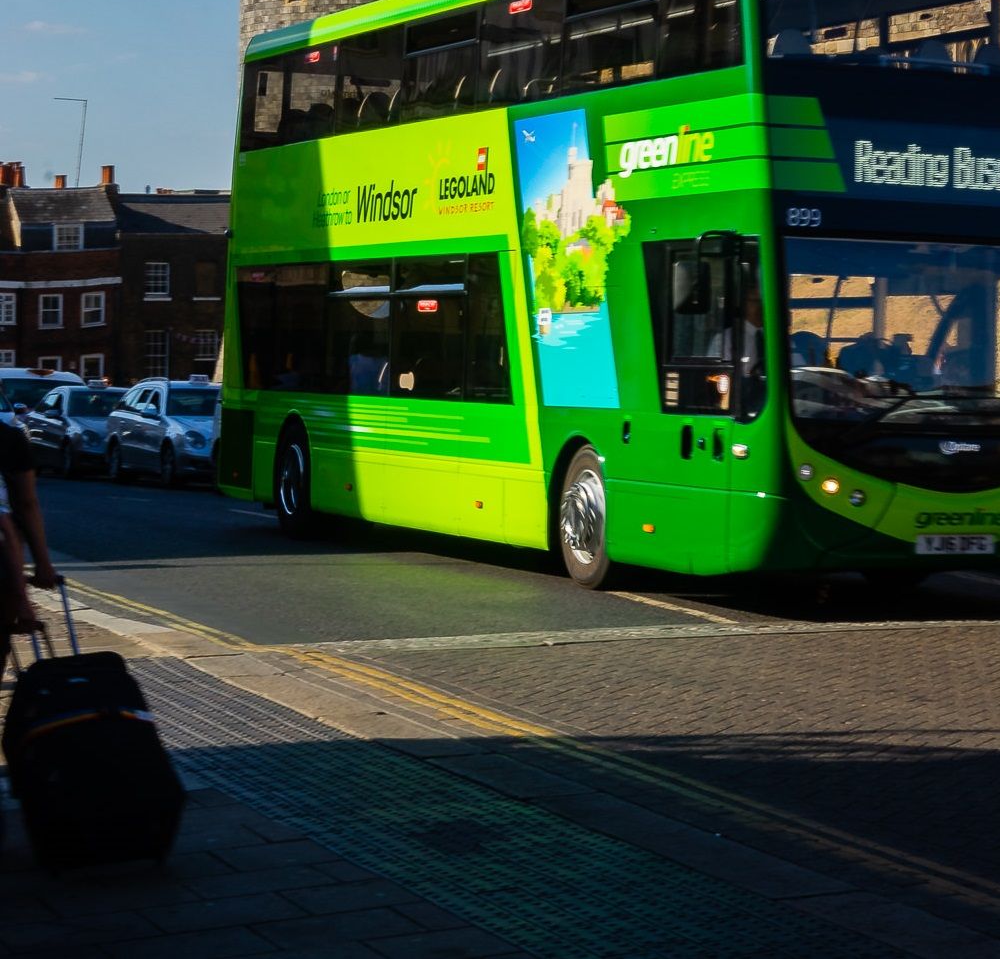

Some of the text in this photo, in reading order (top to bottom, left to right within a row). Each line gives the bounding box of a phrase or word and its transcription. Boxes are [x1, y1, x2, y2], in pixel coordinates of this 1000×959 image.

[618, 125, 714, 178] greenline
[854, 140, 949, 187] Reading
[356, 180, 417, 223] Windsor
[439, 173, 495, 200] LEGOLAND
[439, 201, 494, 216] WINDSOR RESORT
[787, 208, 821, 227] 899
